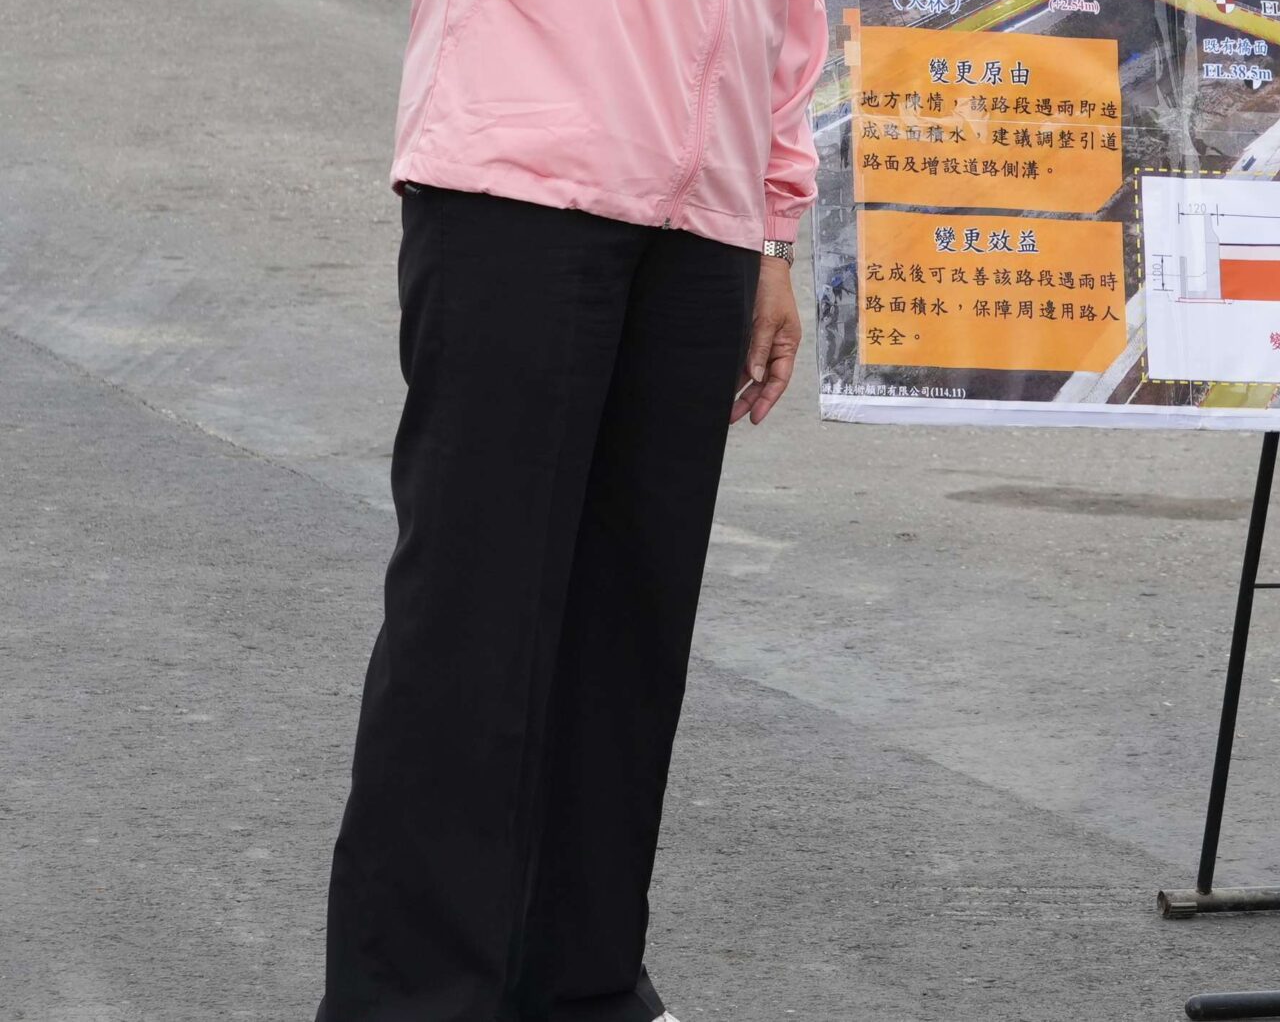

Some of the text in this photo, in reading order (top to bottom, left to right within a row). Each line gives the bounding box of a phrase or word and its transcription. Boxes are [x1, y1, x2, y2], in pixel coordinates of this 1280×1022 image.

[1203, 38, 1268, 57] 既有橋面
[929, 58, 1030, 85] 變更原由
[1203, 63, 1272, 81] EL.38.5m
[862, 153, 1054, 179] 路面及增設道路側溝。
[934, 227, 1039, 254] 變更效益
[866, 263, 1118, 291] 完成後可改善該路段遇雨時
[865, 295, 1120, 322] 路面積水，保障周邊用路人
[866, 328, 921, 346] 安全。
